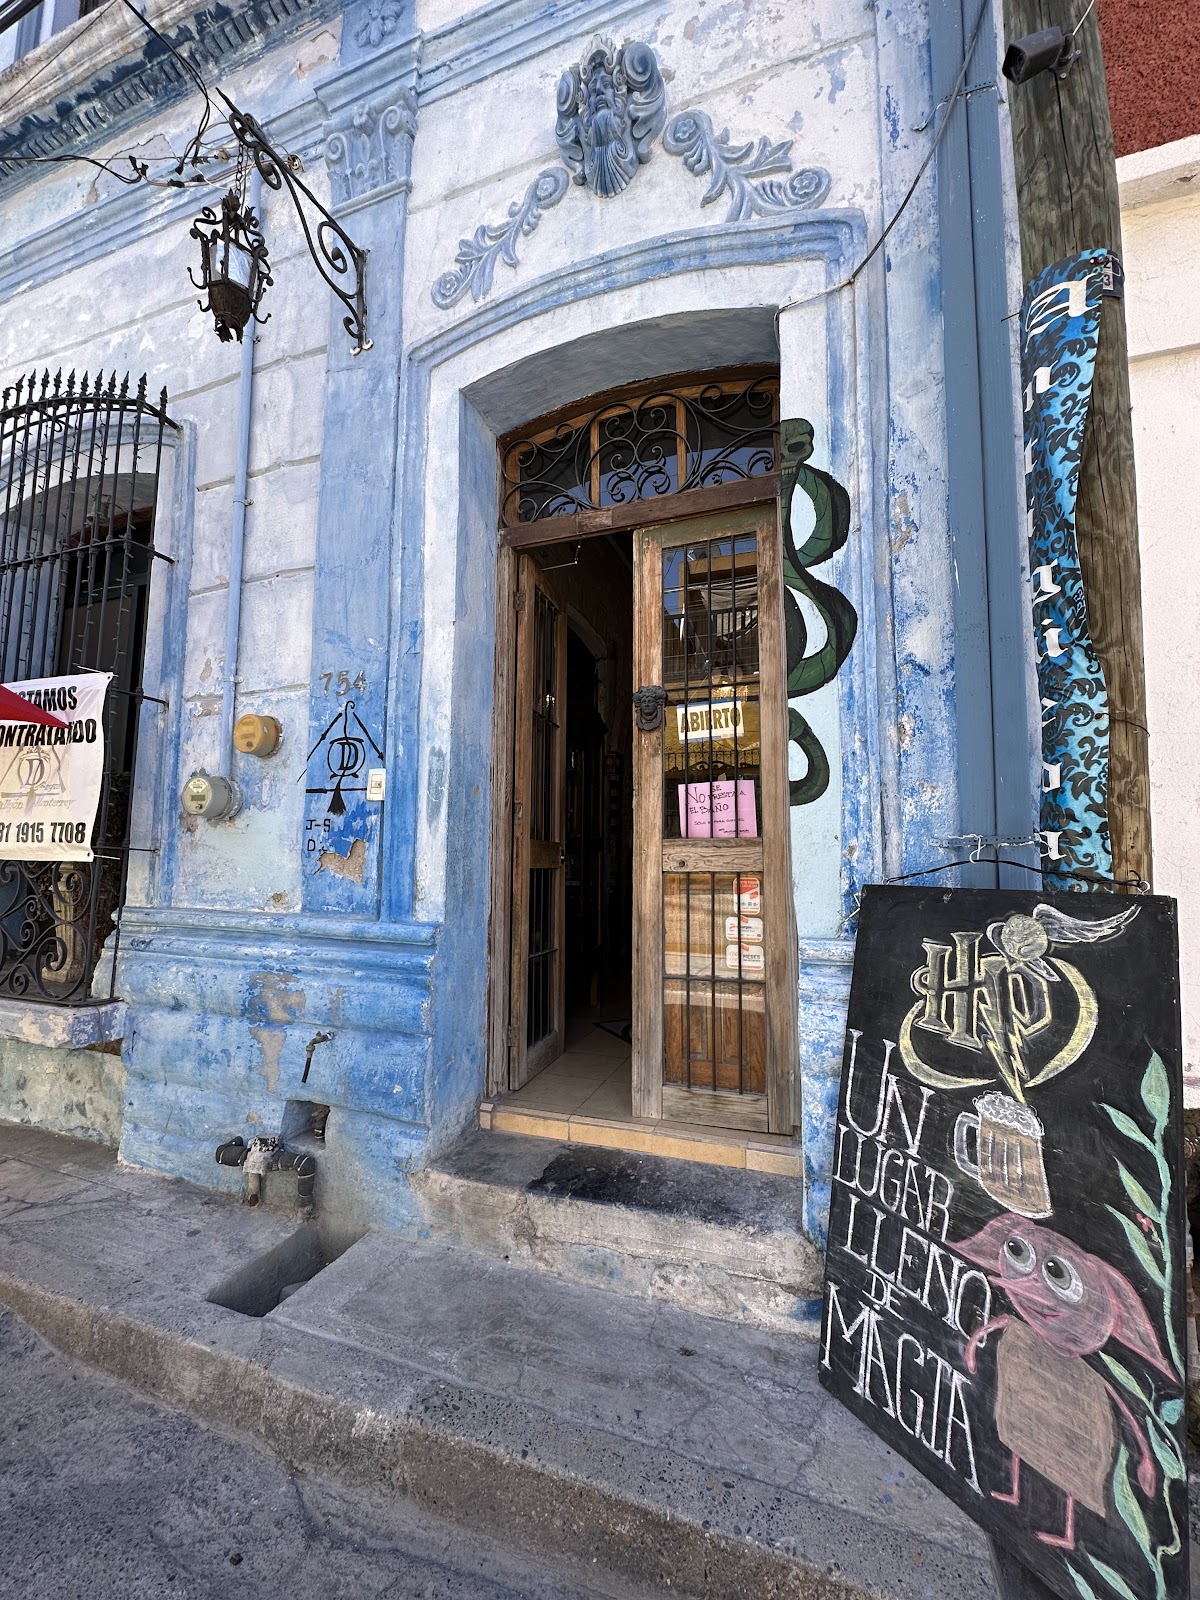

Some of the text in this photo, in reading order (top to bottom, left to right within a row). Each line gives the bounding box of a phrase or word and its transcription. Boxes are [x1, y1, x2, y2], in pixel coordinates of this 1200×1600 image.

[16, 686, 78, 711] TAMOS
[319, 670, 367, 697] 754
[680, 707, 741, 733] ABIERTO
[16, 822, 44, 843] 1915
[51, 822, 86, 843] 7708
[845, 1028, 936, 1159] UN
[832, 1123, 955, 1243] LUGAR
[843, 1193, 992, 1349] LLENO
[862, 1268, 906, 1321] DE
[820, 1280, 985, 1498] MAGIA
